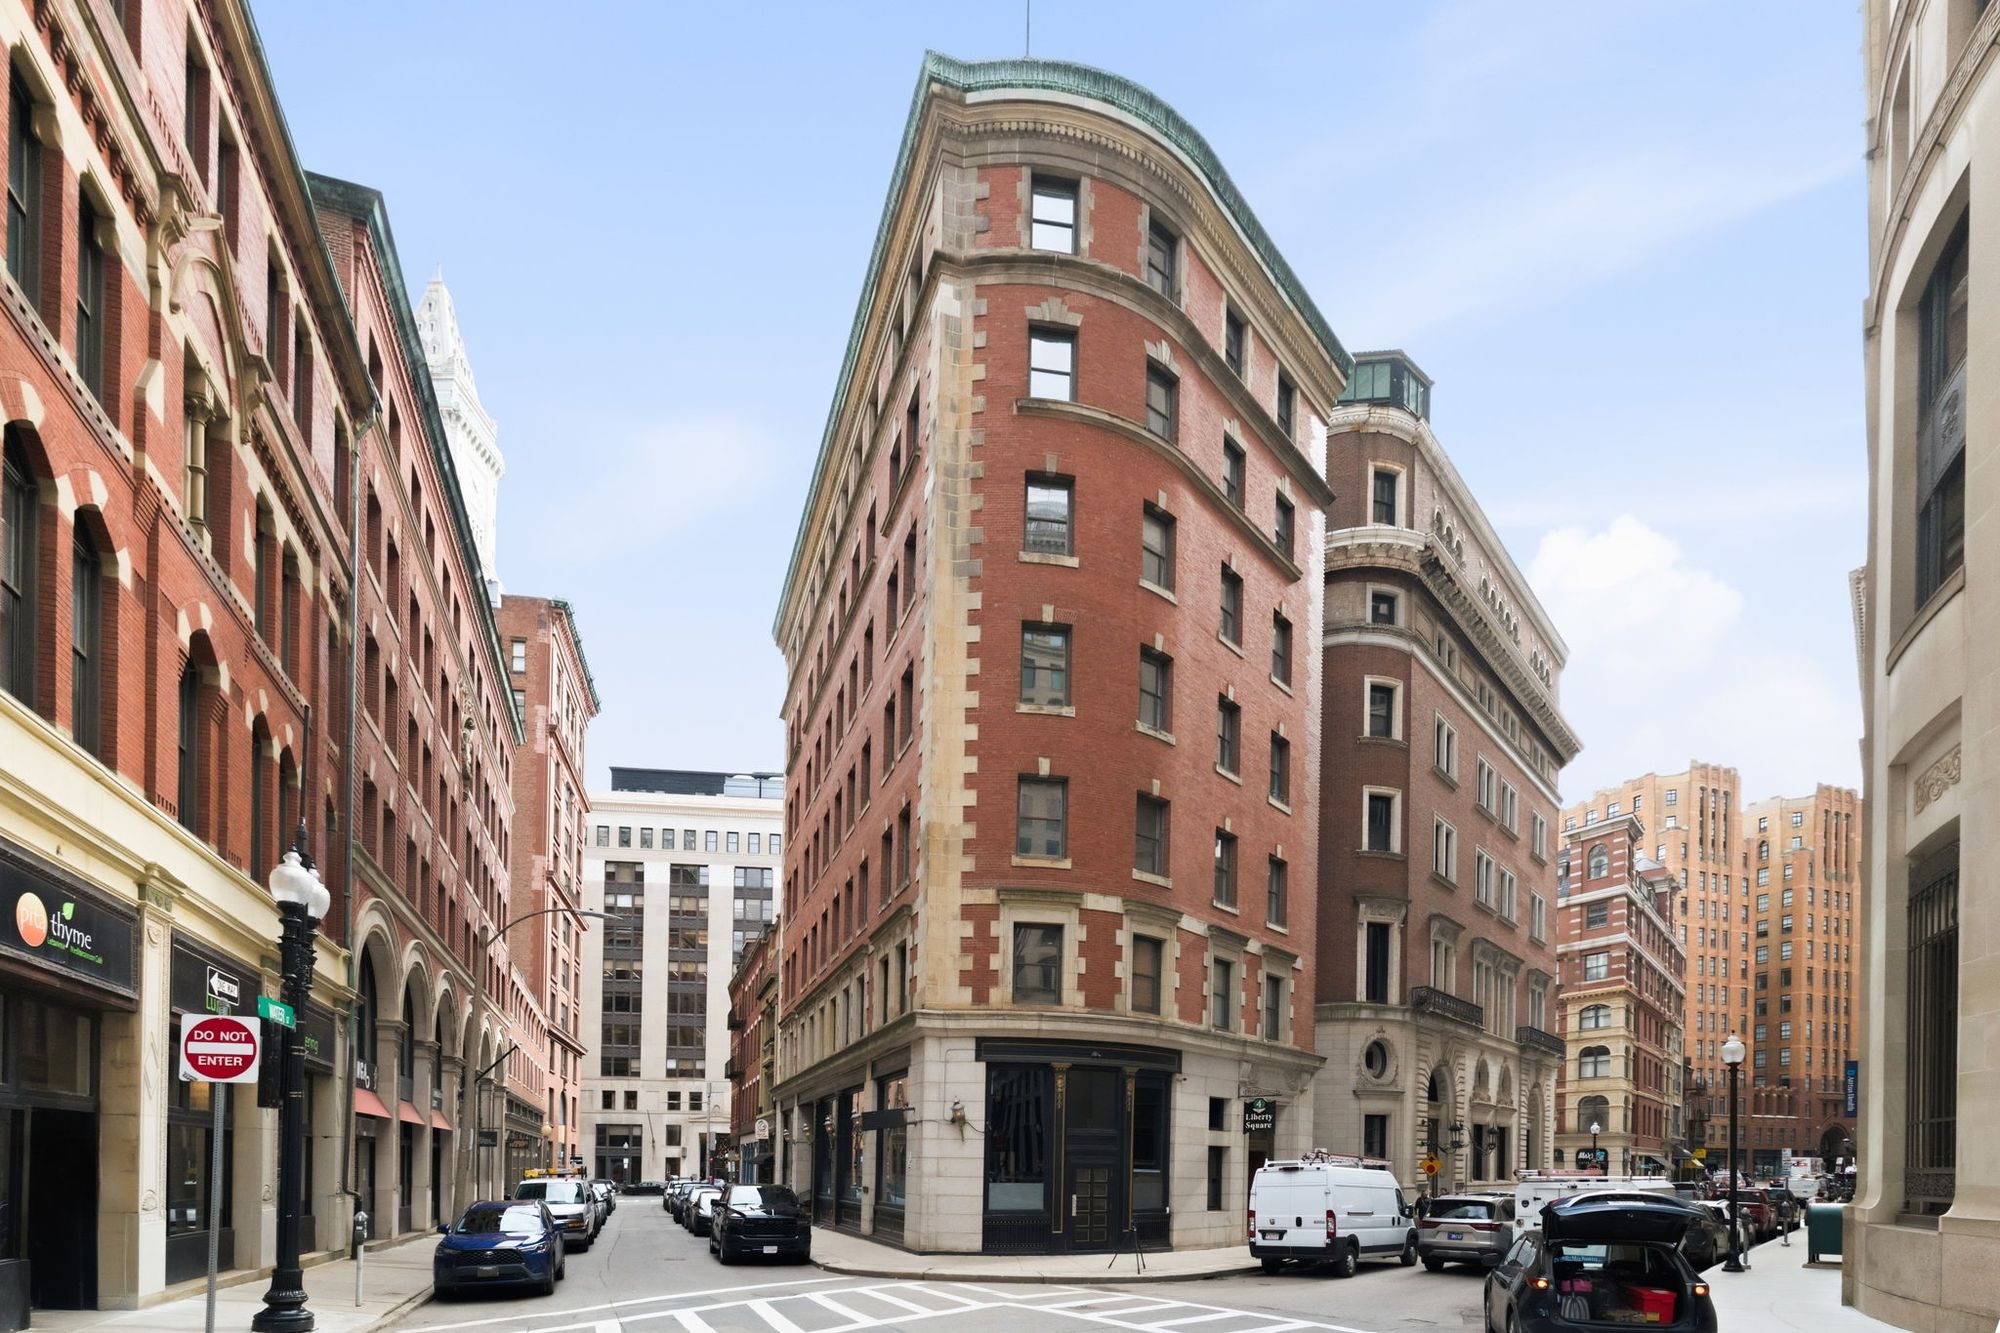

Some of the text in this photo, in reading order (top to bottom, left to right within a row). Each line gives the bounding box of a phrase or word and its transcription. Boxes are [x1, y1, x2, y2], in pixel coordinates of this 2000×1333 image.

[19, 908, 92, 950] pita thyme
[193, 1030, 248, 1042] DO NOT
[197, 1055, 243, 1067] ENTER
[1256, 1100, 1262, 1108] 4
[1245, 1113, 1273, 1122] Liberty
[1245, 1121, 1273, 1131] Square
